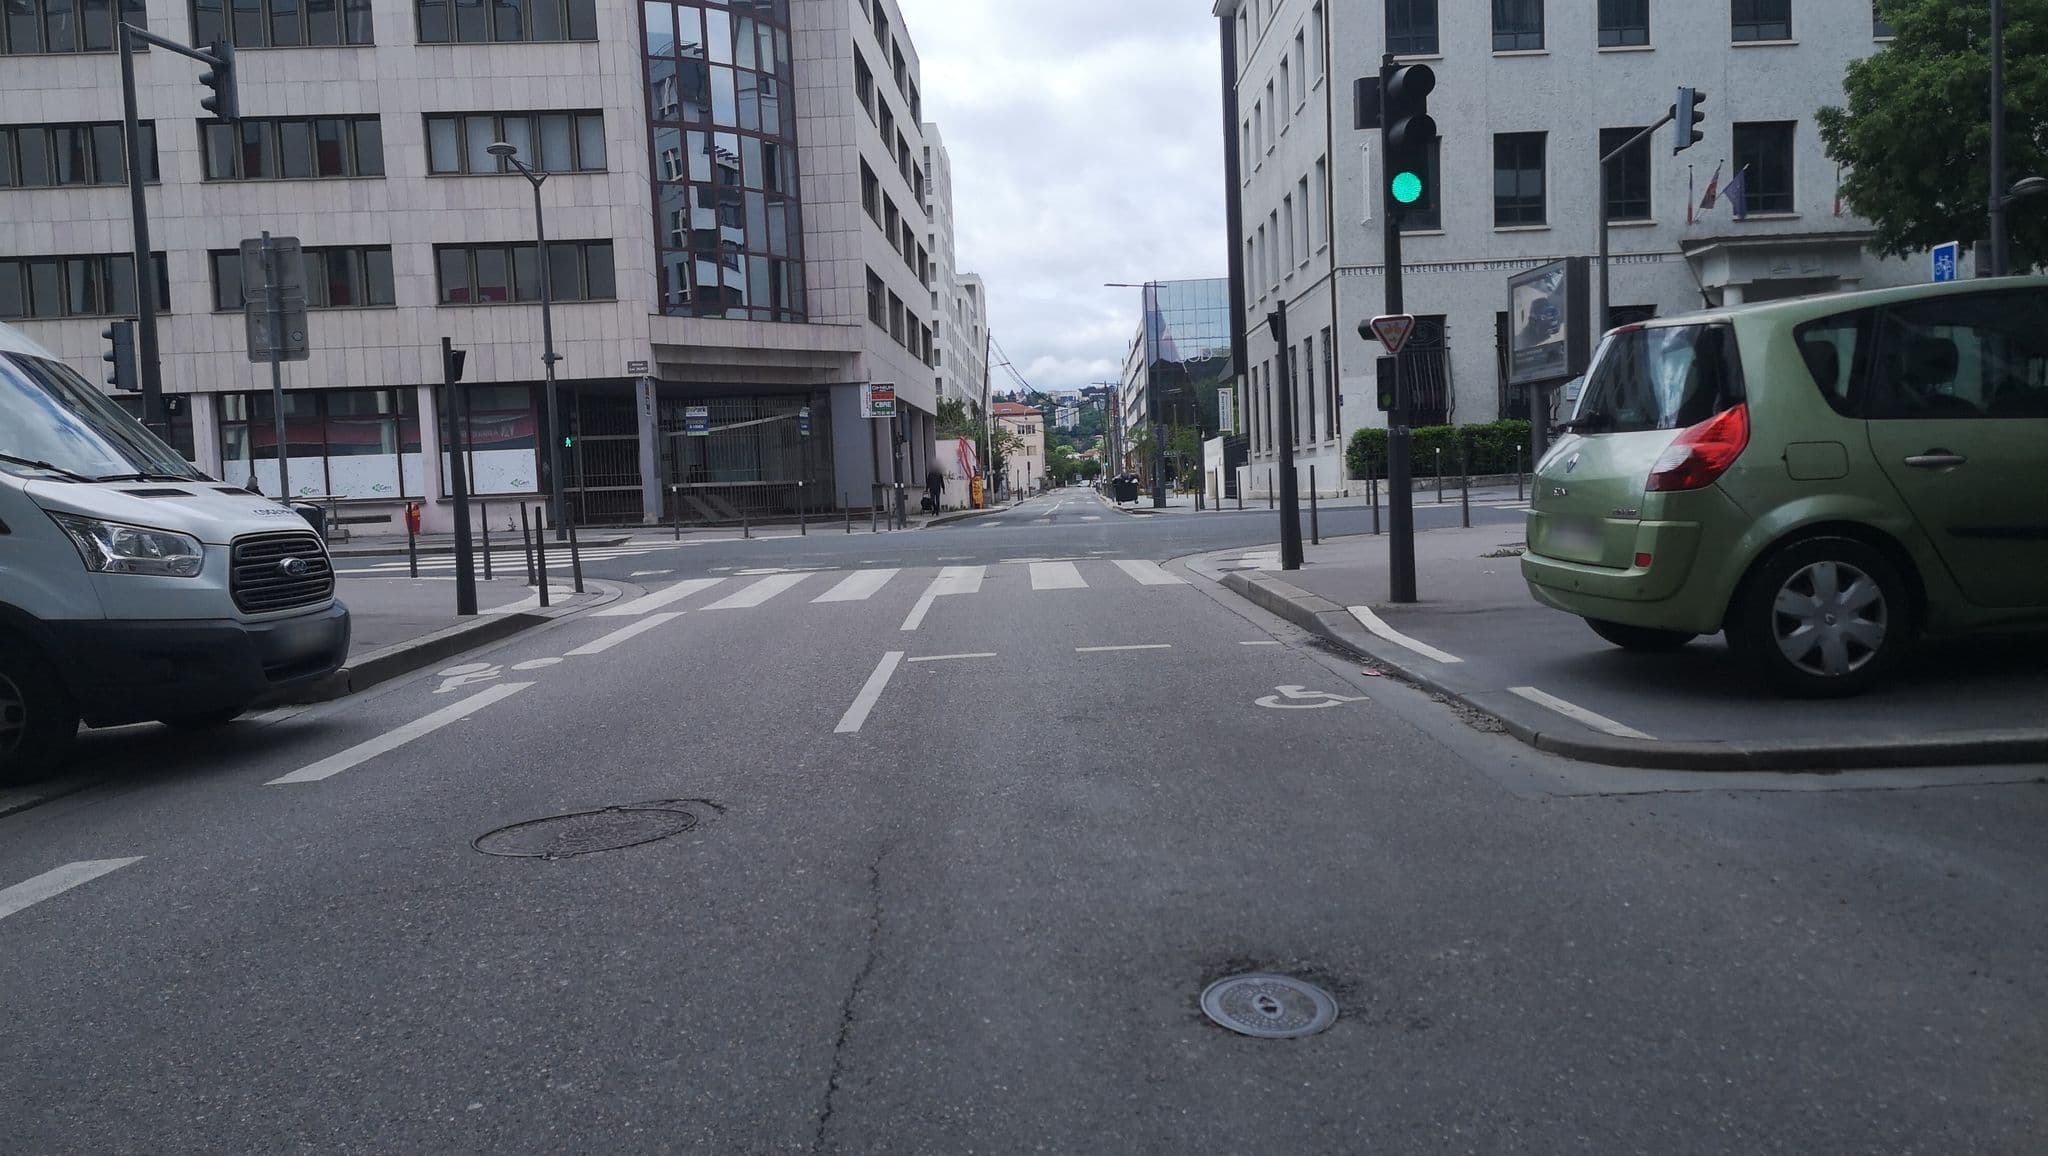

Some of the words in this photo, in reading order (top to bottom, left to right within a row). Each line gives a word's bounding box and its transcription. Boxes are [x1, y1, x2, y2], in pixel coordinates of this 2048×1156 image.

[1340, 266, 1384, 276] BELLEVU
[1403, 263, 1476, 273] ENSEIGNEMENT
[1483, 260, 1538, 270] SUPERIEUR
